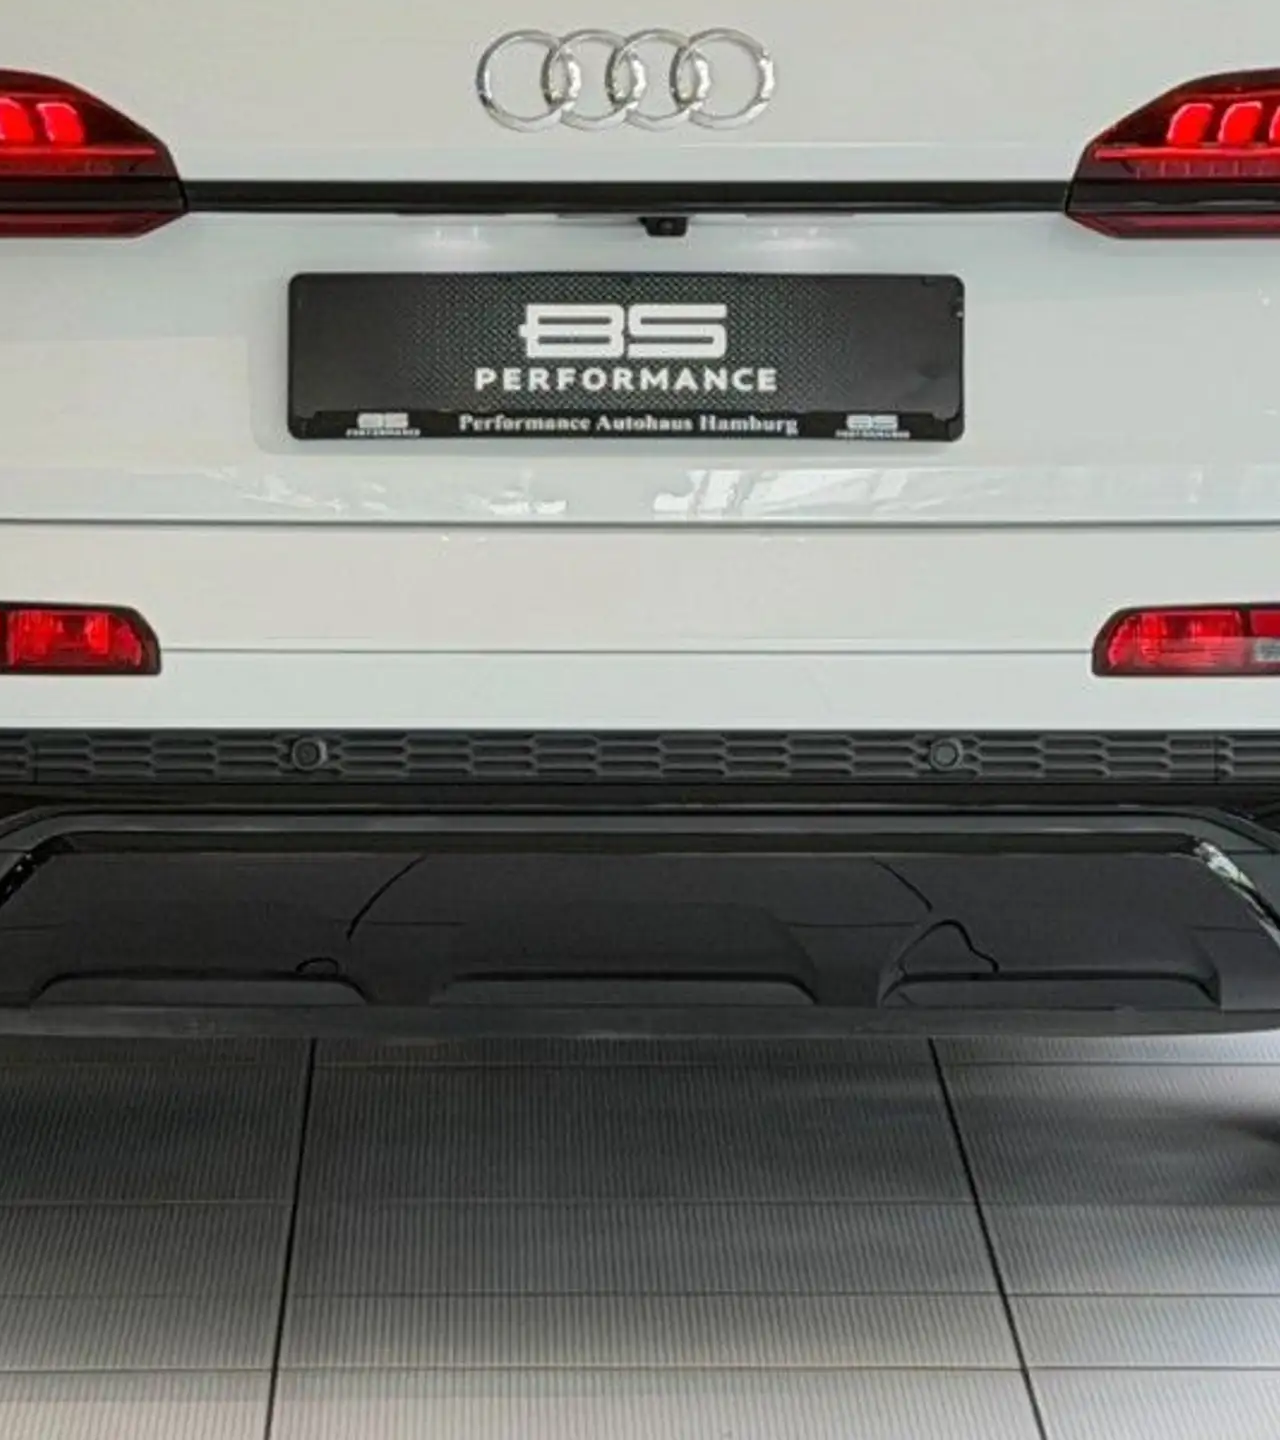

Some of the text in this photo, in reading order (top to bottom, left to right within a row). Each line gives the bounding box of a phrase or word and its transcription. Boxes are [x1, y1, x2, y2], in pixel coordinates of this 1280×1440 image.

[518, 303, 727, 359] BS
[475, 367, 777, 392] PERFORMANCE
[459, 414, 799, 436] Performance Autohaus Hamburg
